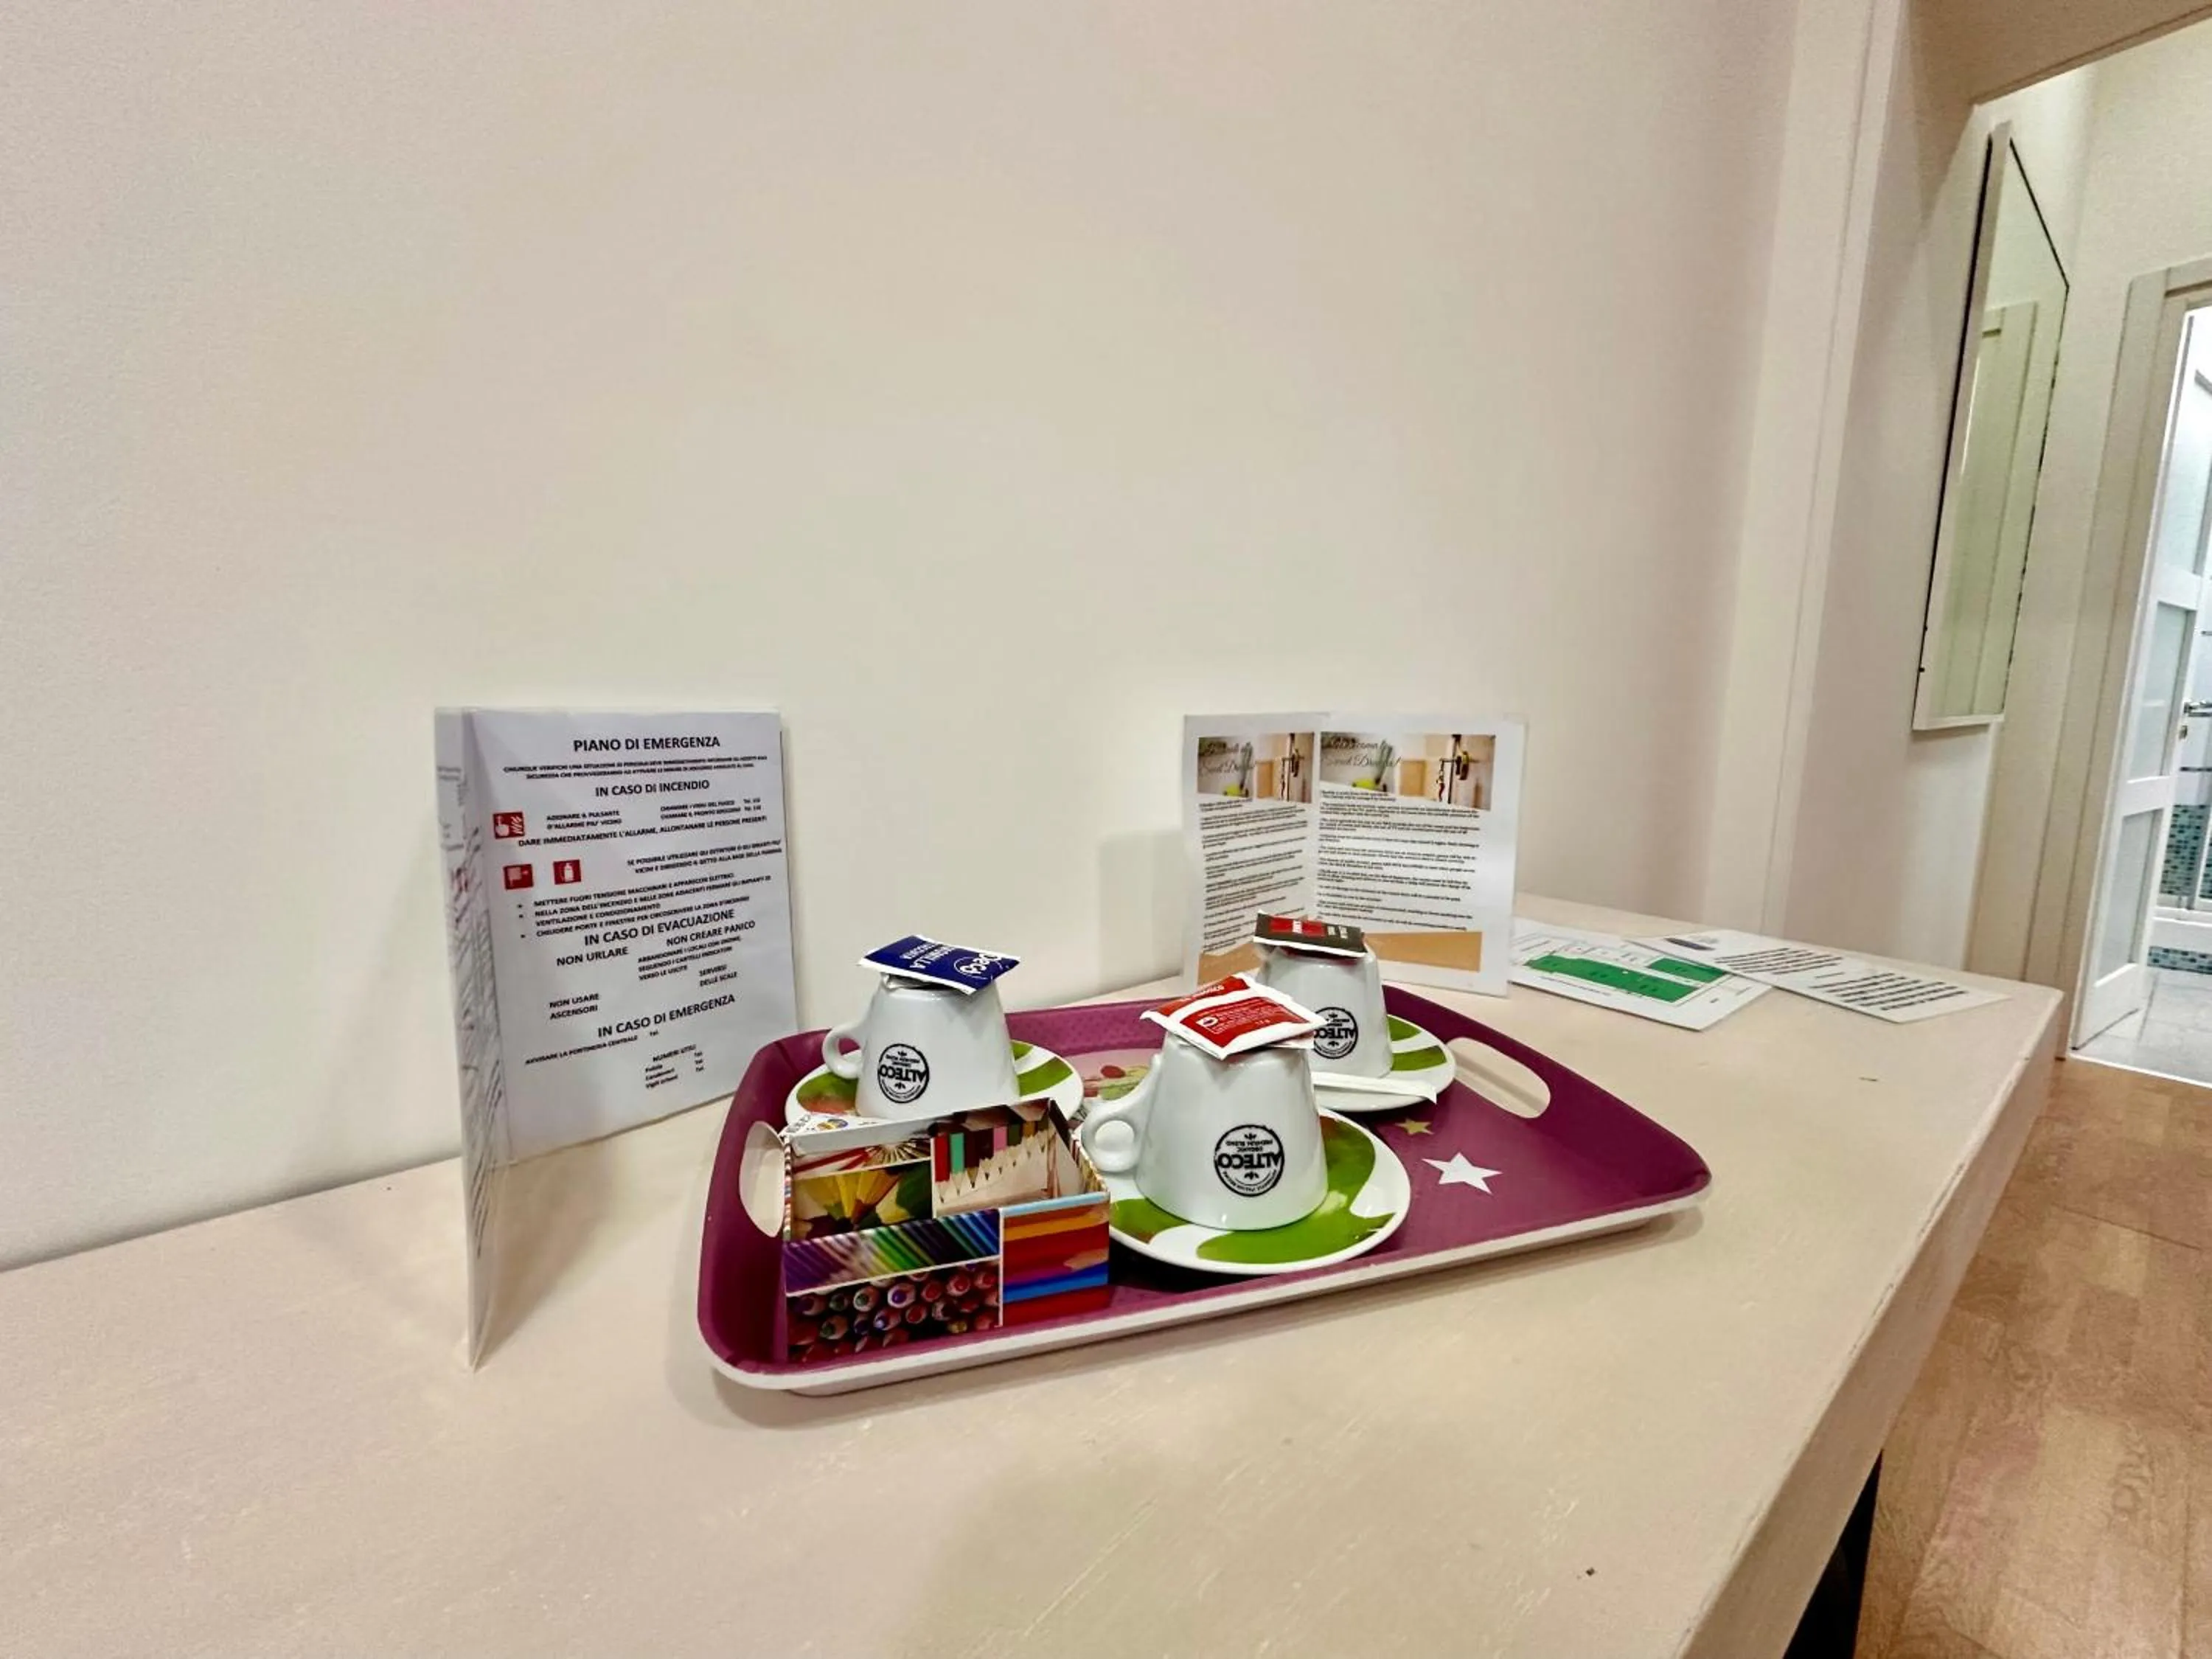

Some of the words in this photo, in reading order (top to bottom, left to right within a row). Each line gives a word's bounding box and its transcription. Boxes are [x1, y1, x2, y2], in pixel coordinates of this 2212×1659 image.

[574, 739, 621, 751] PIANO
[625, 739, 639, 750] DI
[644, 737, 720, 749] EMERGENZA
[596, 787, 609, 796] IN
[612, 785, 642, 795] CASO
[646, 785, 657, 793] DI
[660, 780, 710, 792] INCENDIO
[543, 832, 617, 844] IMMEDIATAMENTE
[660, 823, 706, 832] ALLONTANARE
[534, 898, 568, 906] METTERE
[594, 890, 626, 899] TENSIONE
[582, 899, 633, 911] DELL'INCENDIO
[536, 914, 588, 926] VENTILAZIONE
[595, 903, 661, 918] CONDIZIONAMENTO
[536, 926, 573, 936] CHIUDERE
[605, 917, 635, 926] FINESTRE
[585, 934, 600, 945] IN
[603, 928, 639, 942] CASO
[642, 925, 655, 936] DI
[658, 909, 735, 933] EVACUAZIONE
[667, 935, 688, 946] NON
[690, 928, 723, 941] CREARE
[725, 921, 756, 933] PANICO
[557, 955, 583, 966] NON
[586, 947, 629, 961] URLARE
[549, 999, 570, 1008] NON
[572, 993, 599, 1004] USARE
[550, 1005, 599, 1019] ASCENSORI
[598, 1026, 613, 1037] IN
[616, 1018, 651, 1033] CASO
[654, 1013, 667, 1024] DI
[669, 995, 735, 1020] EMERGENZA
[1314, 1028, 1357, 1039] ALTECO
[879, 1064, 928, 1083] ALTECO
[1217, 1152, 1282, 1169] ALTECO
